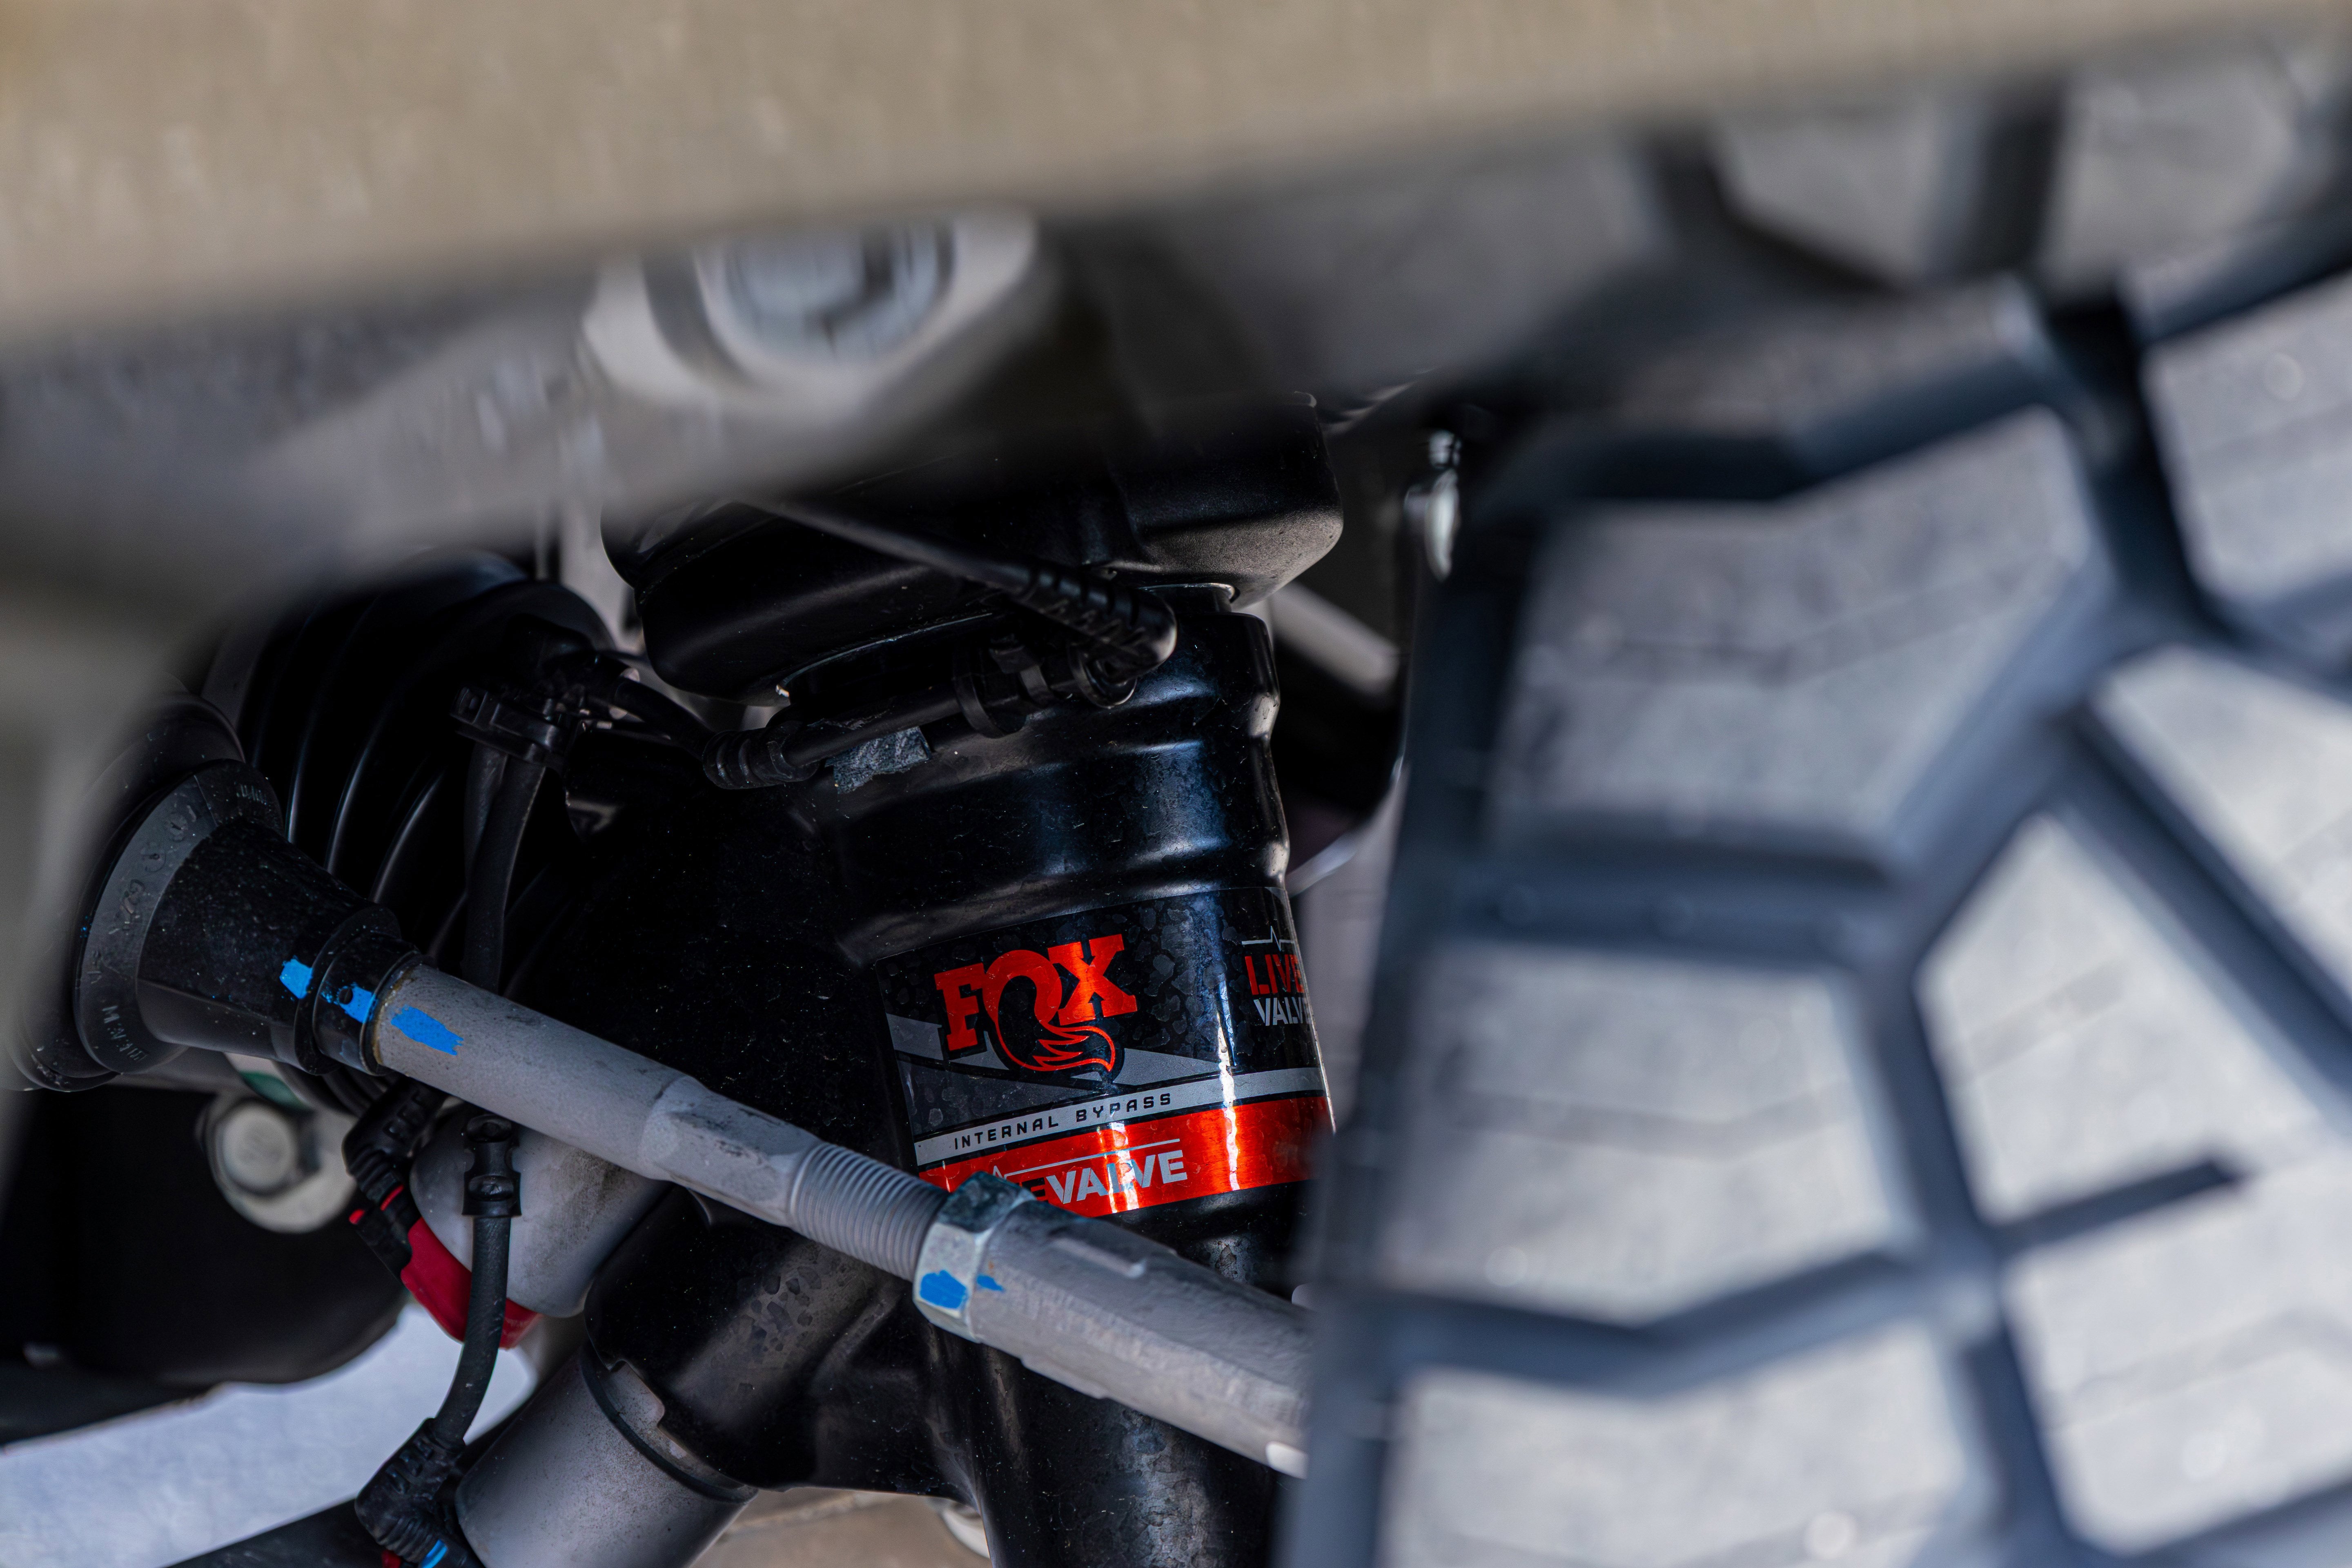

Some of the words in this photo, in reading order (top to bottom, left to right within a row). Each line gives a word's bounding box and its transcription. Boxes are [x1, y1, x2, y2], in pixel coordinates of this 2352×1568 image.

[934, 934, 1138, 1073] FOX
[1254, 997, 1306, 1027] VALV
[954, 1116, 1059, 1150] INTERNAL
[1076, 1092, 1171, 1123] BYPASS
